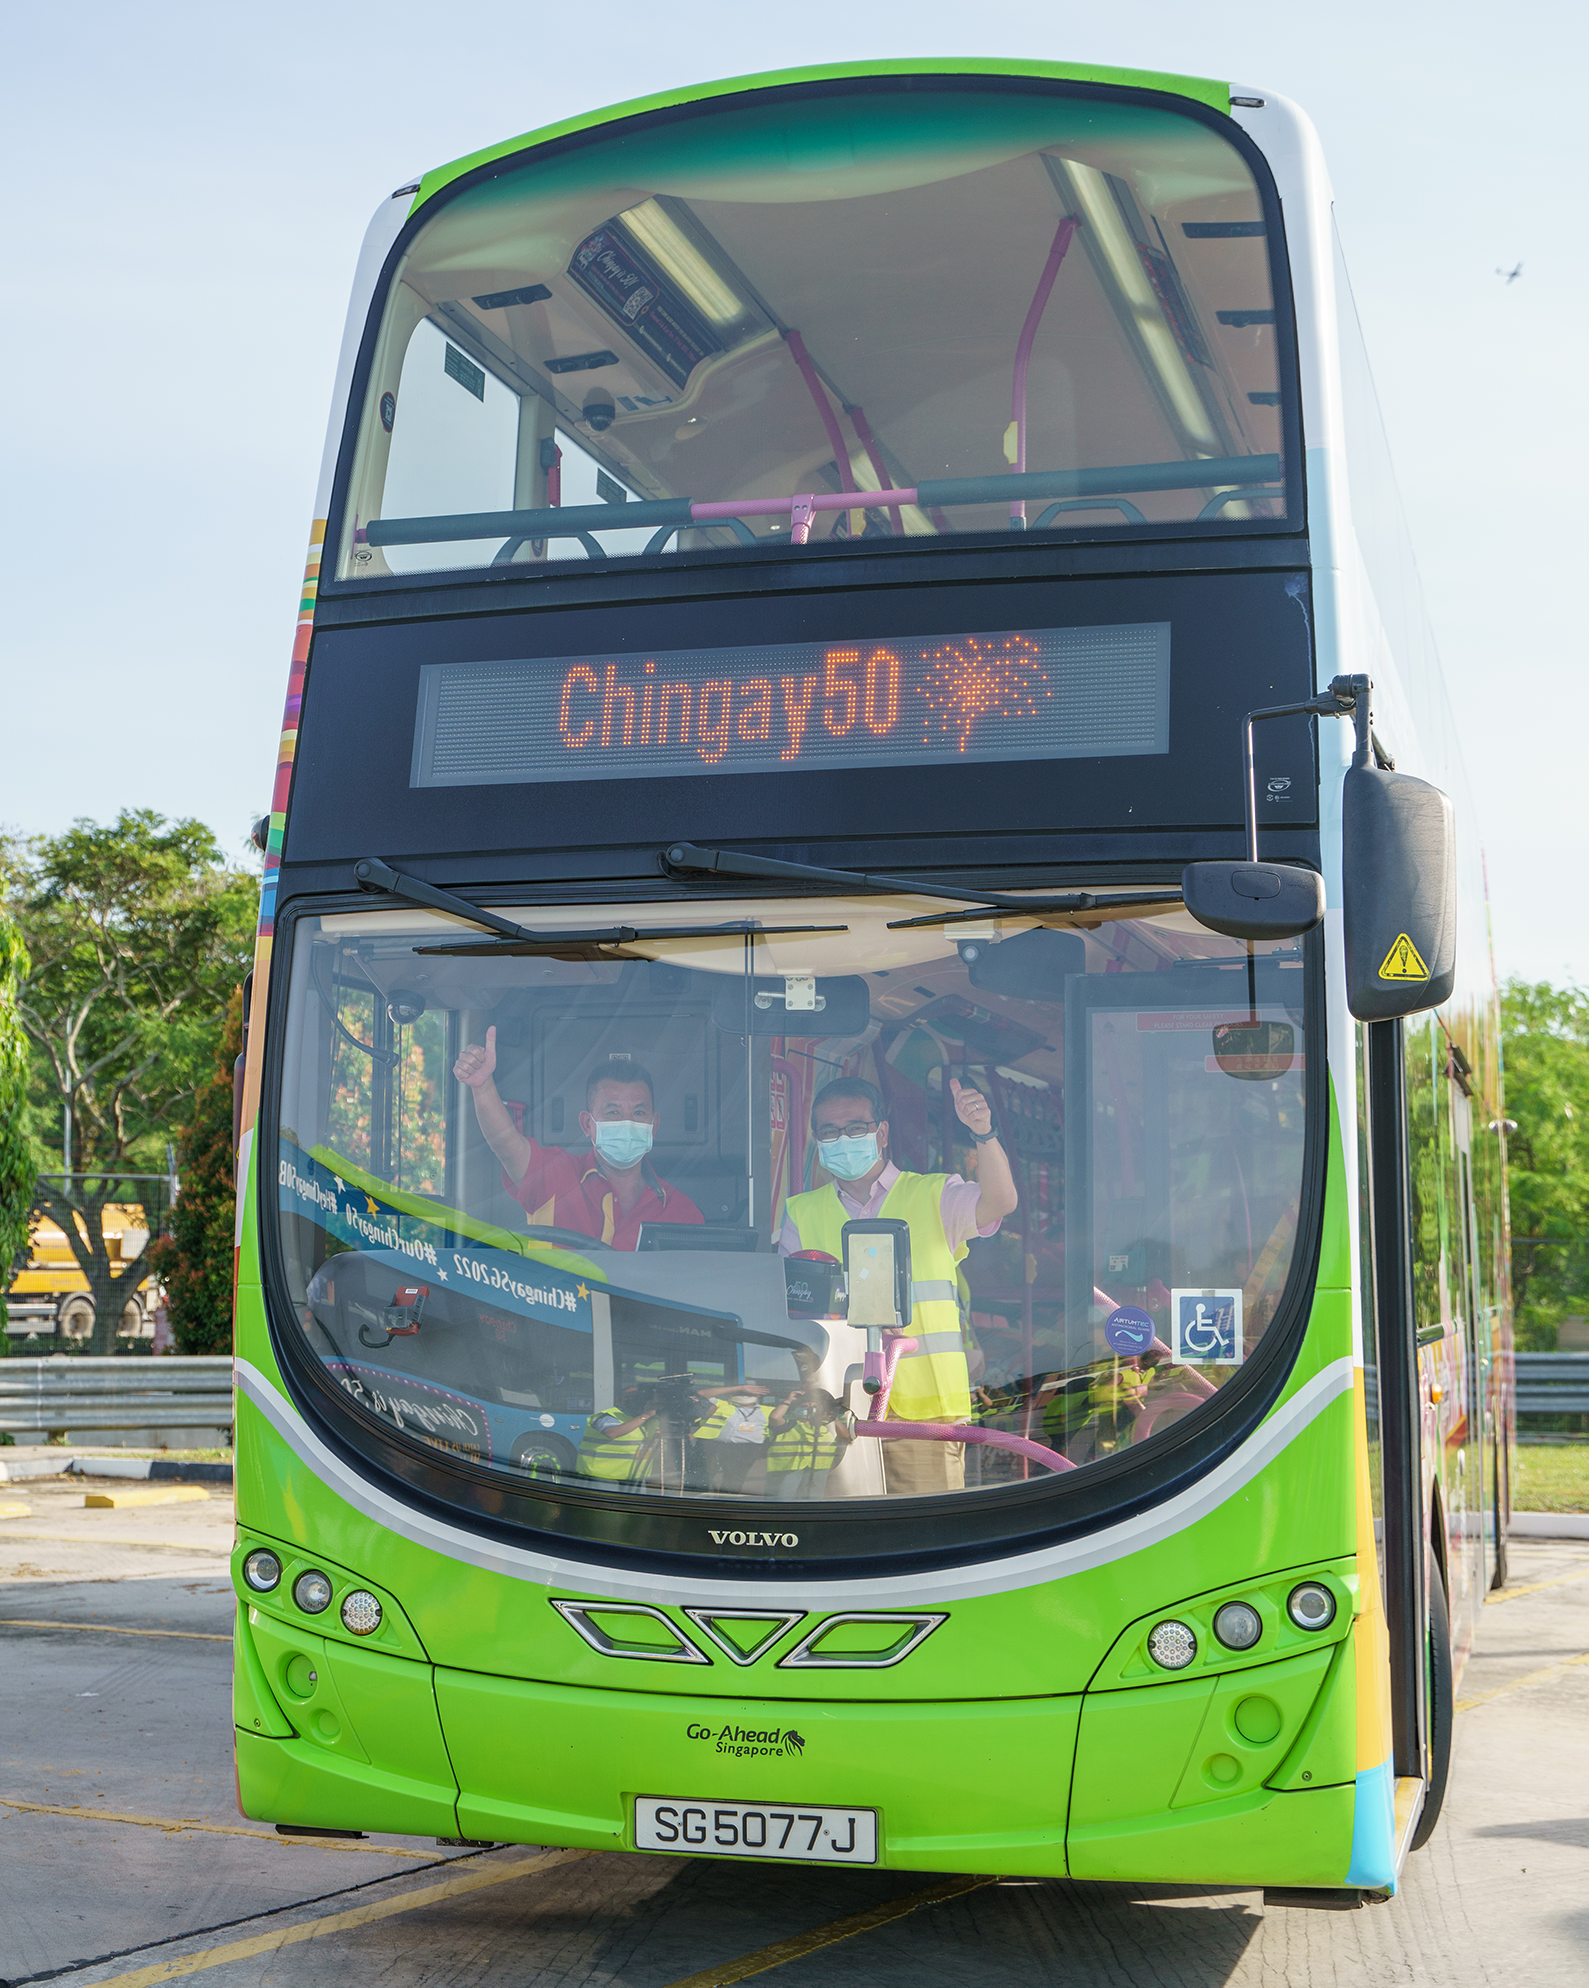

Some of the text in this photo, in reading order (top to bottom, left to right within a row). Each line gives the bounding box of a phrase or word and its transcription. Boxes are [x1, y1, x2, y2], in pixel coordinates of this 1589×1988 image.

[707, 1530, 799, 1548] VOLVO
[686, 1723, 781, 1744] Go-Ahead
[715, 1741, 784, 1758] Singapore
[655, 1806, 856, 1853] SG5077J
